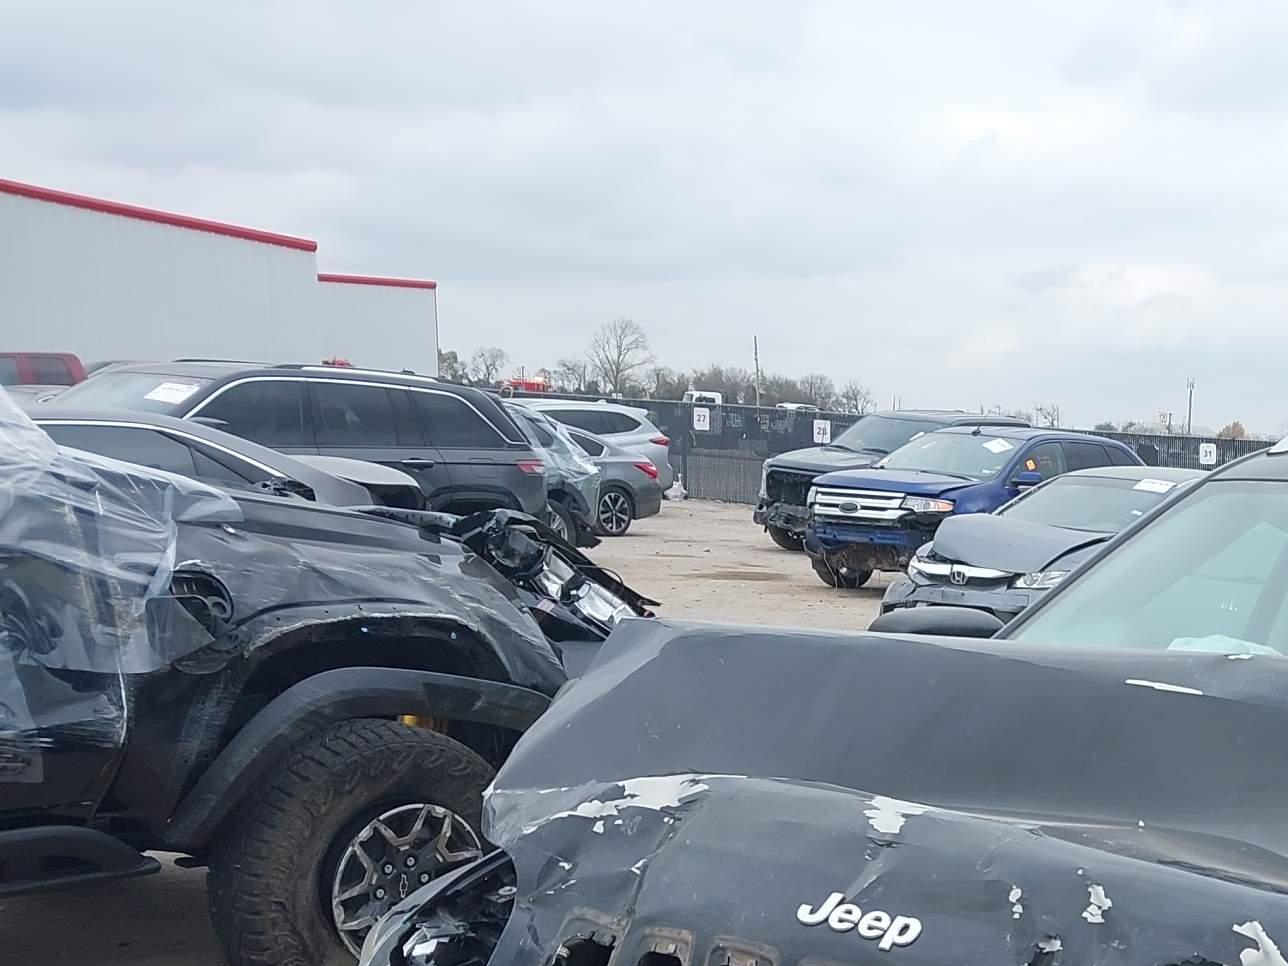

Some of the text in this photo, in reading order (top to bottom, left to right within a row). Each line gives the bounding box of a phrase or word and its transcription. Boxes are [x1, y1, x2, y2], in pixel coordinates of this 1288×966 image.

[696, 414, 706, 423] 27
[1203, 449, 1212, 458] 31
[797, 892, 922, 951] Jeep
